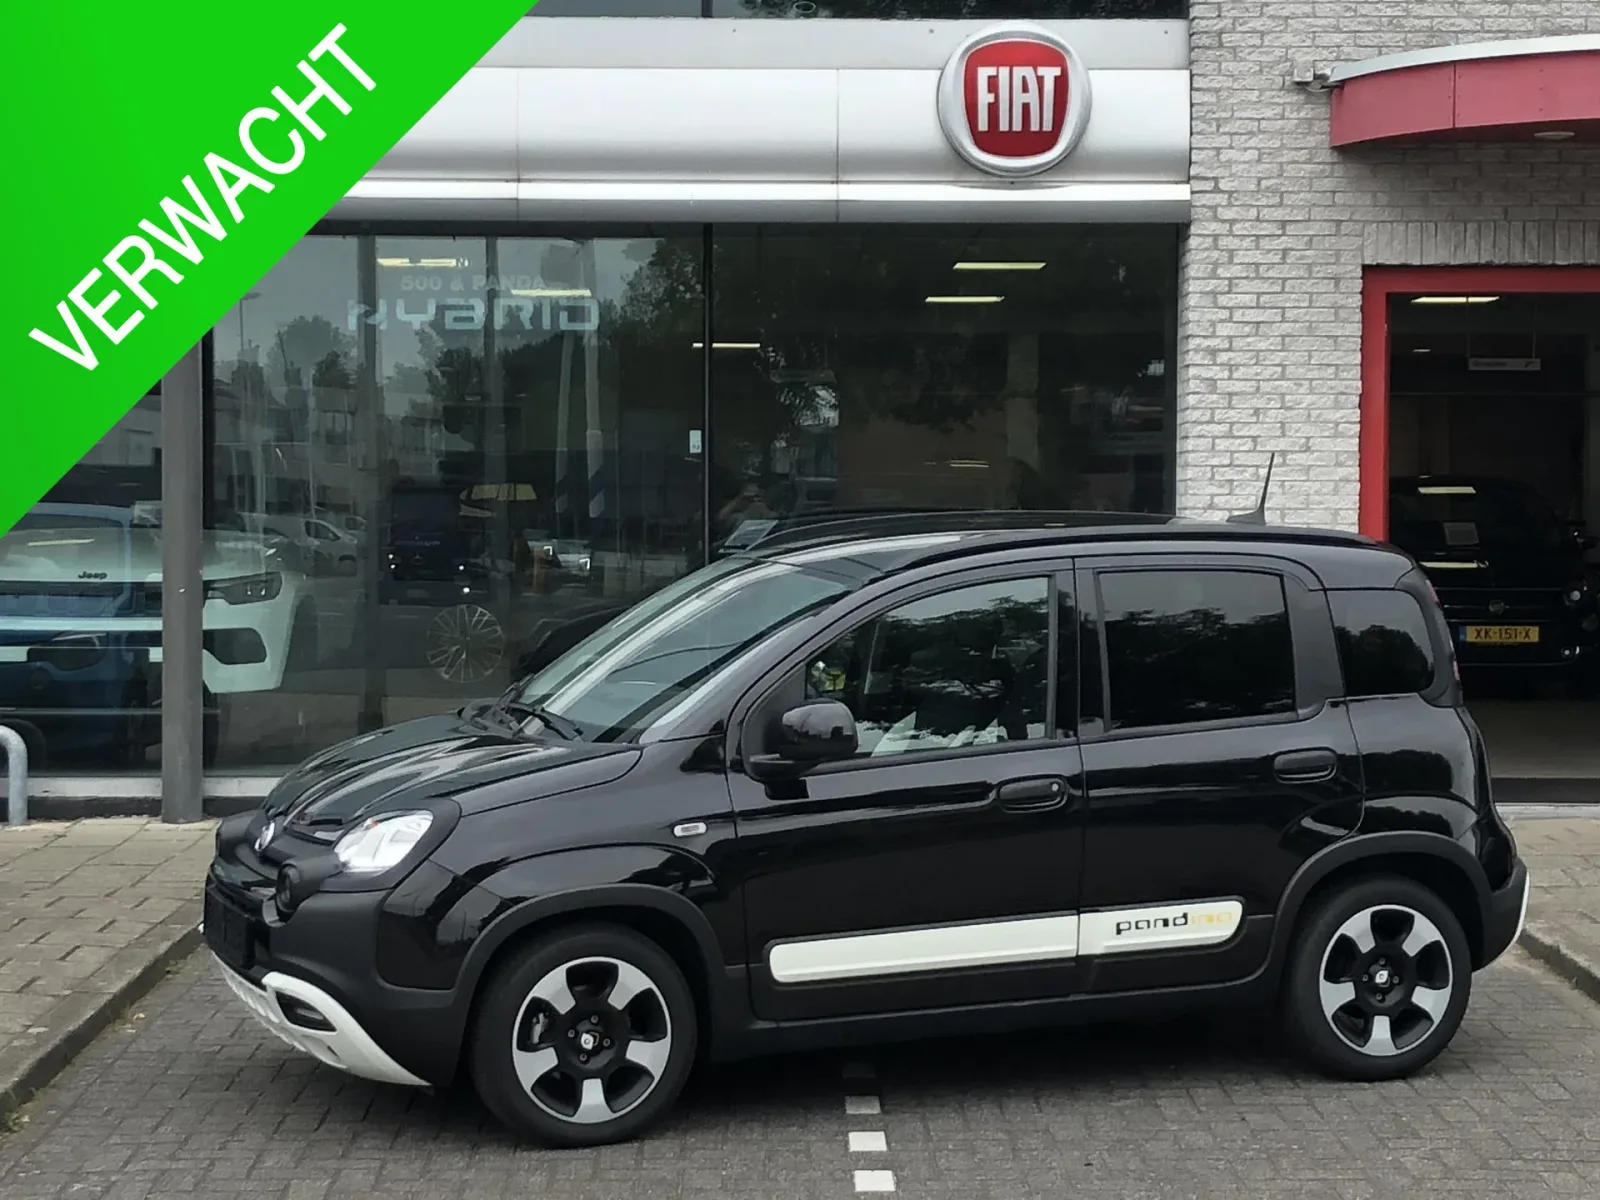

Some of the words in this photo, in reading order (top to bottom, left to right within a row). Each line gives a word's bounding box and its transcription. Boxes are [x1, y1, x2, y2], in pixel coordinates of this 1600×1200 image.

[976, 66, 1061, 132] FIAT
[401, 275, 442, 291] 500
[450, 275, 464, 291] &
[472, 275, 546, 291] PANDA
[348, 299, 599, 330] HYBRID
[78, 571, 107, 580] Jeep
